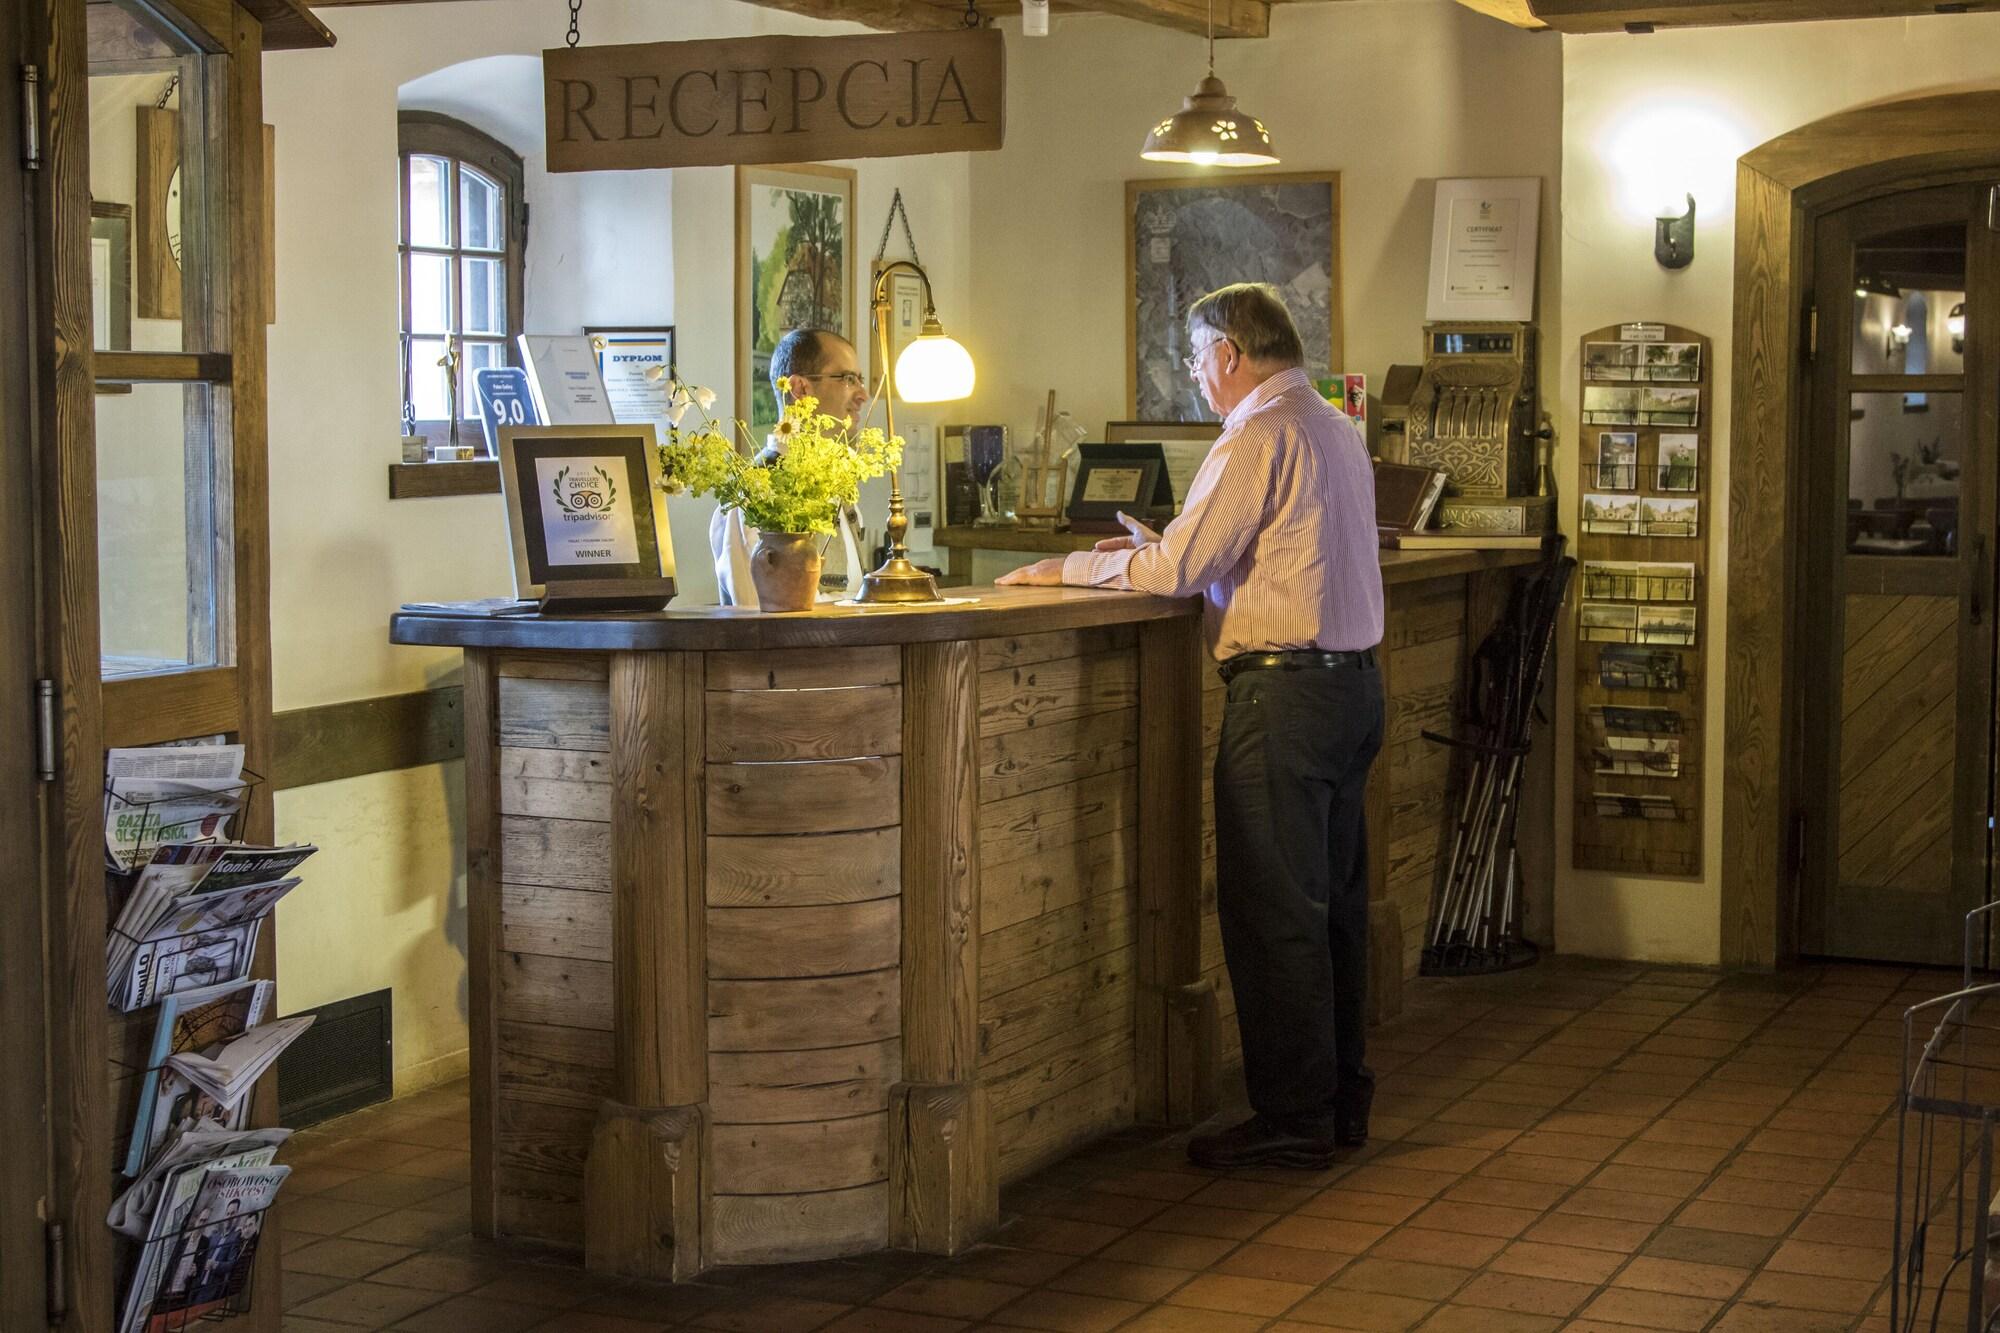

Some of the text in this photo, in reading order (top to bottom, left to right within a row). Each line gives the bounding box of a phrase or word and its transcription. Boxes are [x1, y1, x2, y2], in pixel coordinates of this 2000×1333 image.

[553, 56, 987, 143] RECEPCJA
[612, 354, 663, 363] DYPLOM
[493, 398, 524, 426] 9,0
[569, 481, 600, 489] CHOICE
[563, 511, 613, 523] tripadvisor
[575, 549, 612, 559] WINNER
[212, 859, 253, 873] Konie
